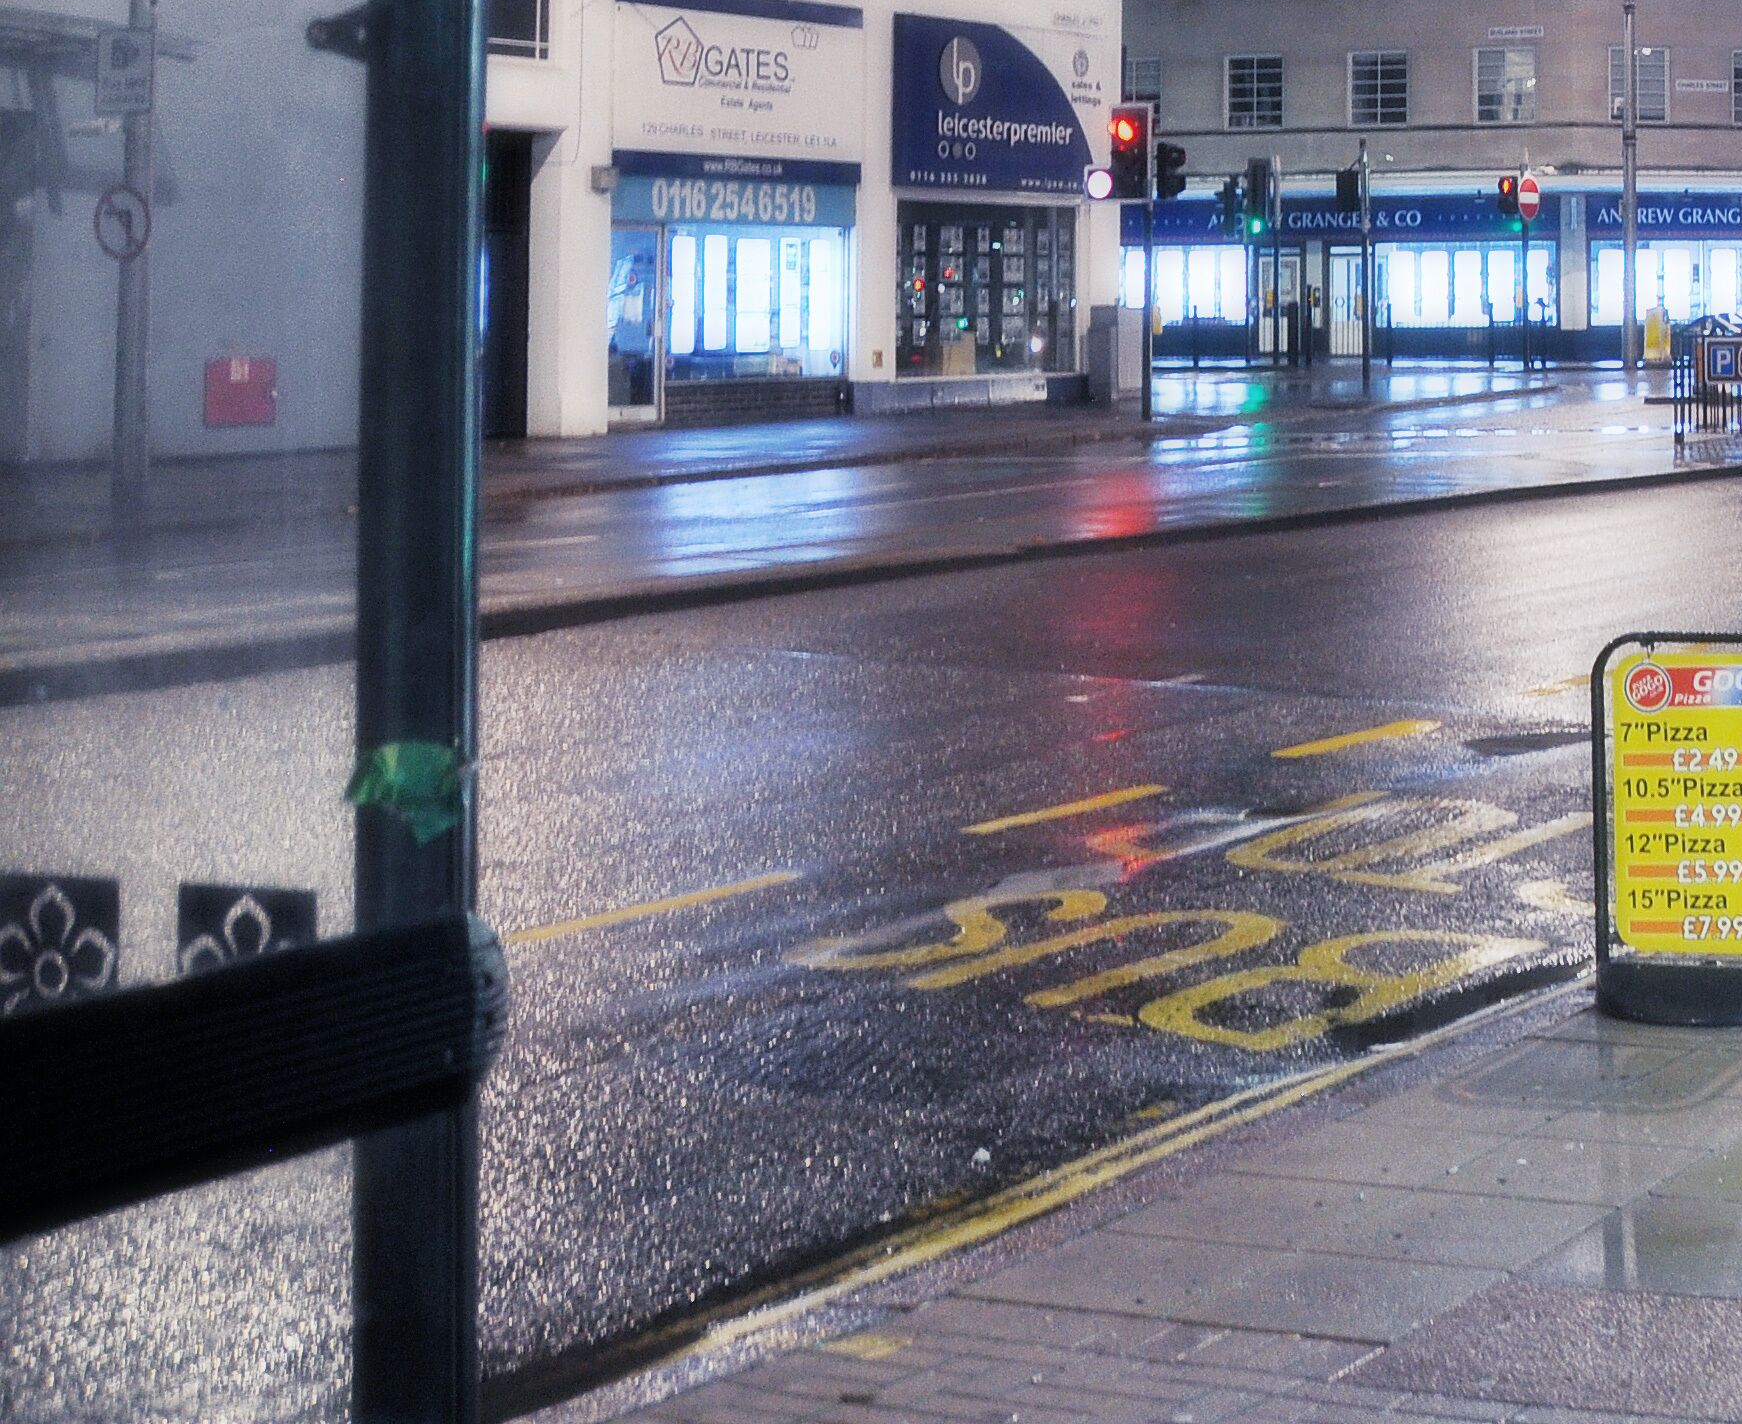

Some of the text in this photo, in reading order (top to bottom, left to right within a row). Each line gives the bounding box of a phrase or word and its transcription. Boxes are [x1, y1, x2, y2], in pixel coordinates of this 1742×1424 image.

[704, 44, 790, 82] GATES
[748, 99, 774, 111] Agents
[937, 109, 1073, 147] leicesterpremier
[652, 178, 707, 219] 0116
[1288, 211, 1371, 228] GRANGE
[1376, 210, 1389, 227] &
[1394, 209, 1422, 227] CO
[1597, 207, 1674, 224] ANREW
[1716, 352, 1732, 375] P
[1674, 693, 1712, 705] Pizza
[1672, 747, 1739, 772] £2.49
[1674, 803, 1742, 829] £4.99
